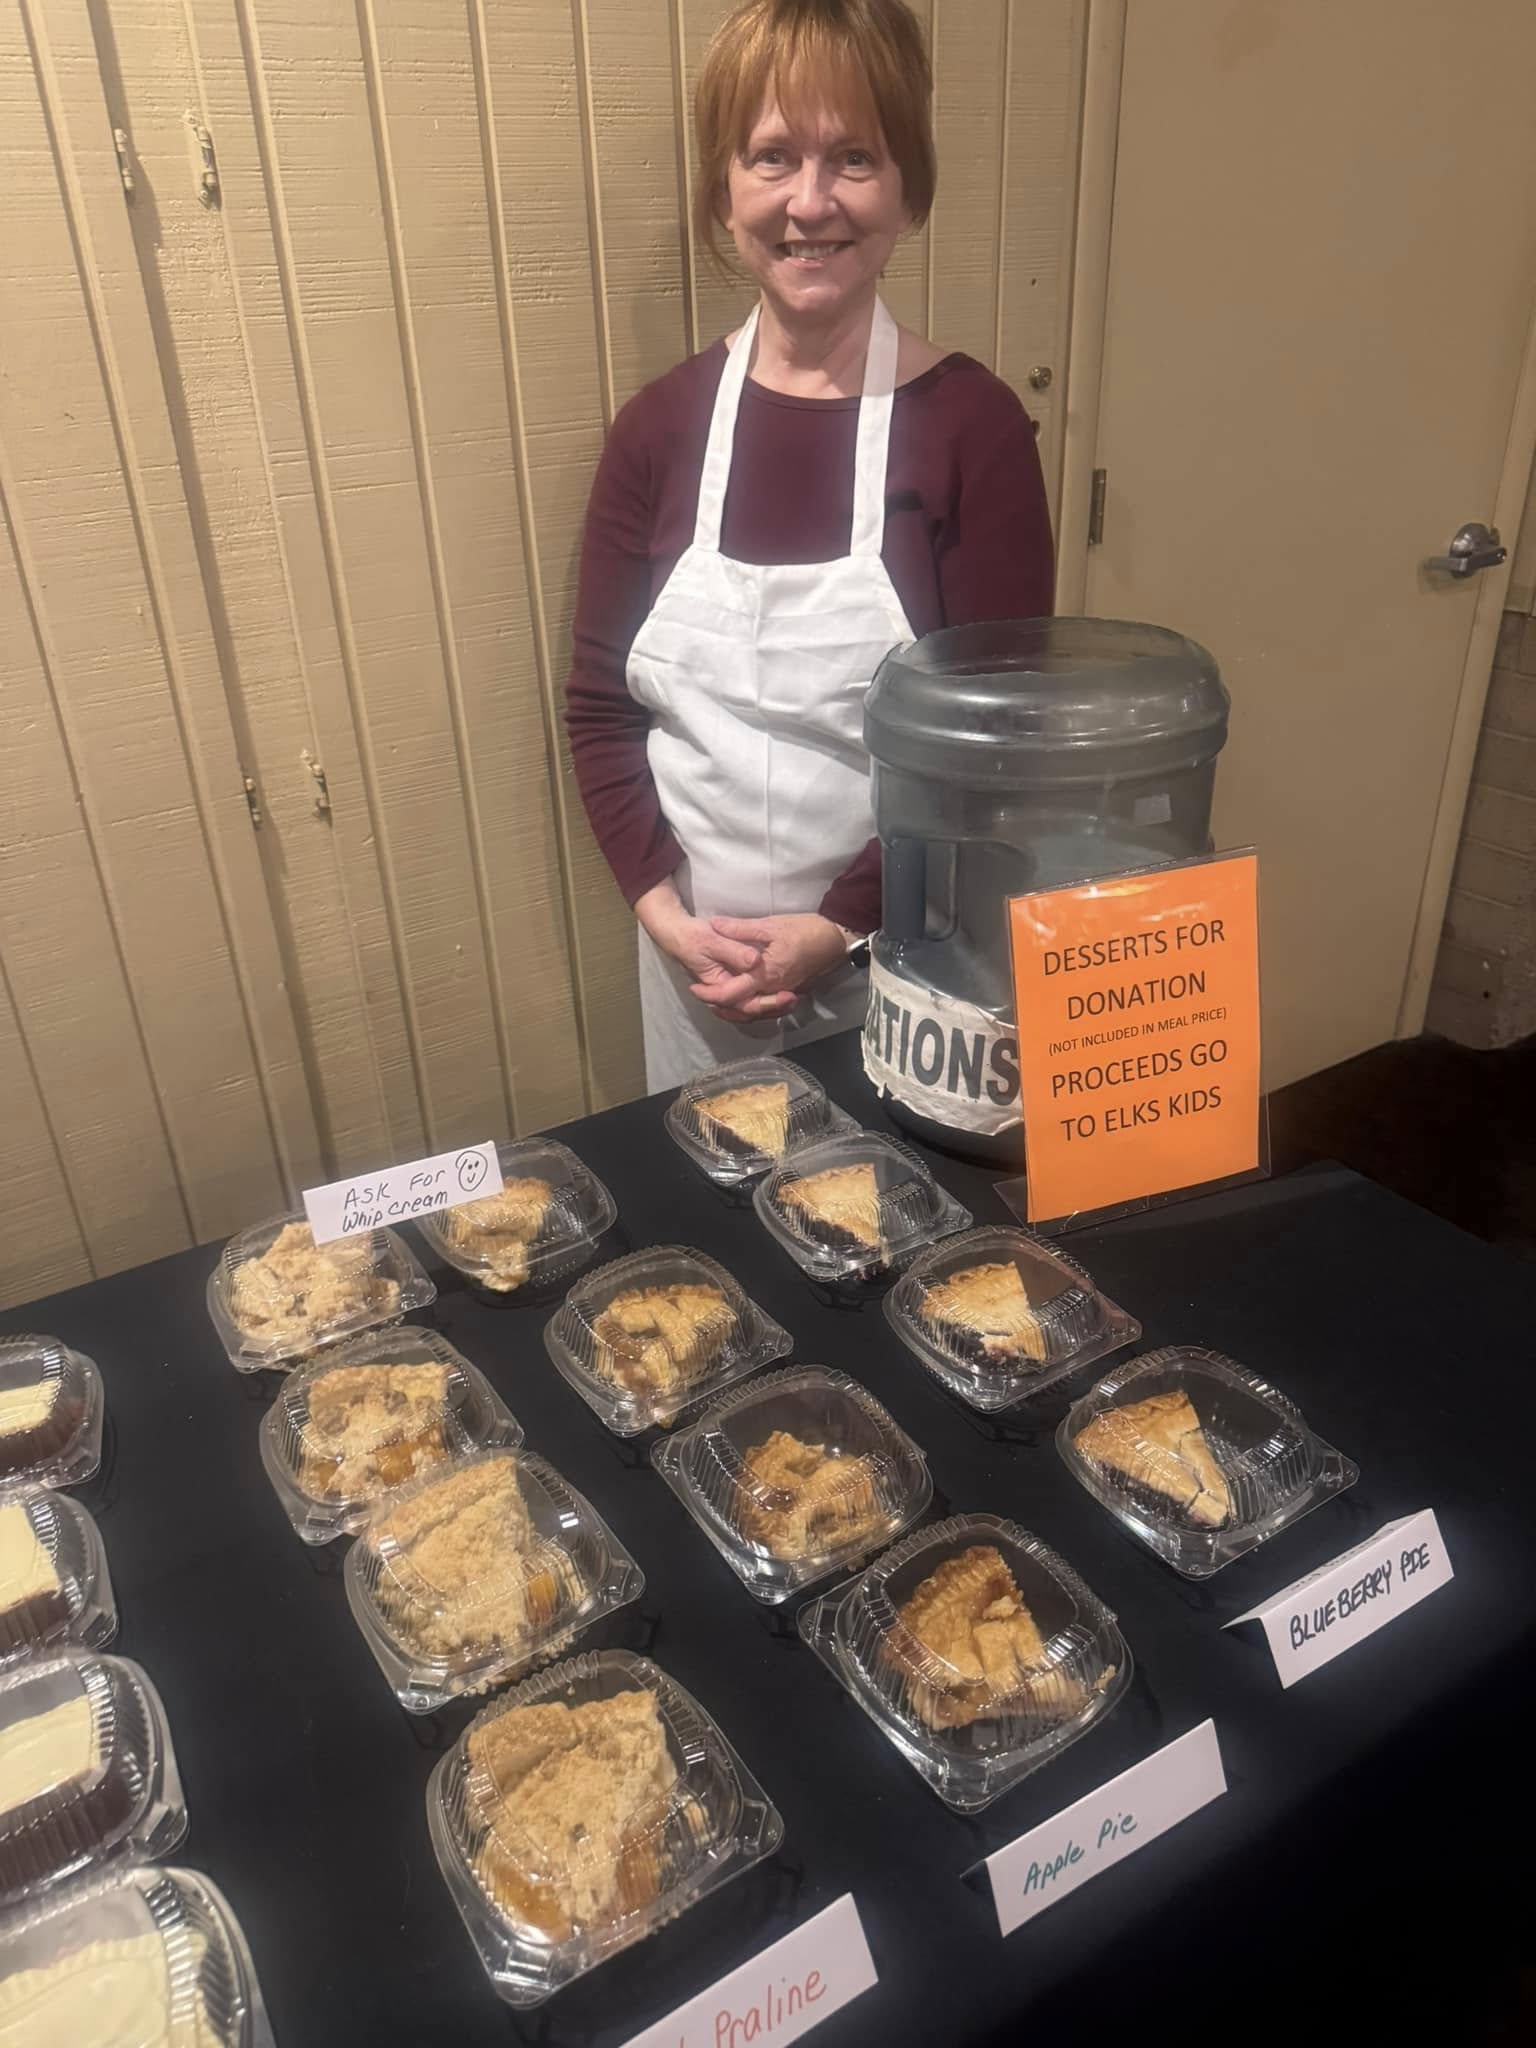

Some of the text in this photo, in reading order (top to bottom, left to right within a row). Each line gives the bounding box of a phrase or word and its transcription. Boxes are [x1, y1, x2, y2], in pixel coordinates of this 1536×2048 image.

[1043, 919, 1225, 976] DESSERTS FOR
[1067, 971, 1206, 1020] DONATION
[1048, 1007, 1228, 1057] (NOT INCLUDED IN MEAL PRICE)
[1052, 1039, 1228, 1099] PROCEEDS GO
[1060, 1086, 1222, 1142] TO ELKS KIDS
[1400, 1542, 1431, 1582] PIE
[1023, 1813, 1138, 1896] Apple Pie
[715, 1969, 828, 2048] Praline
